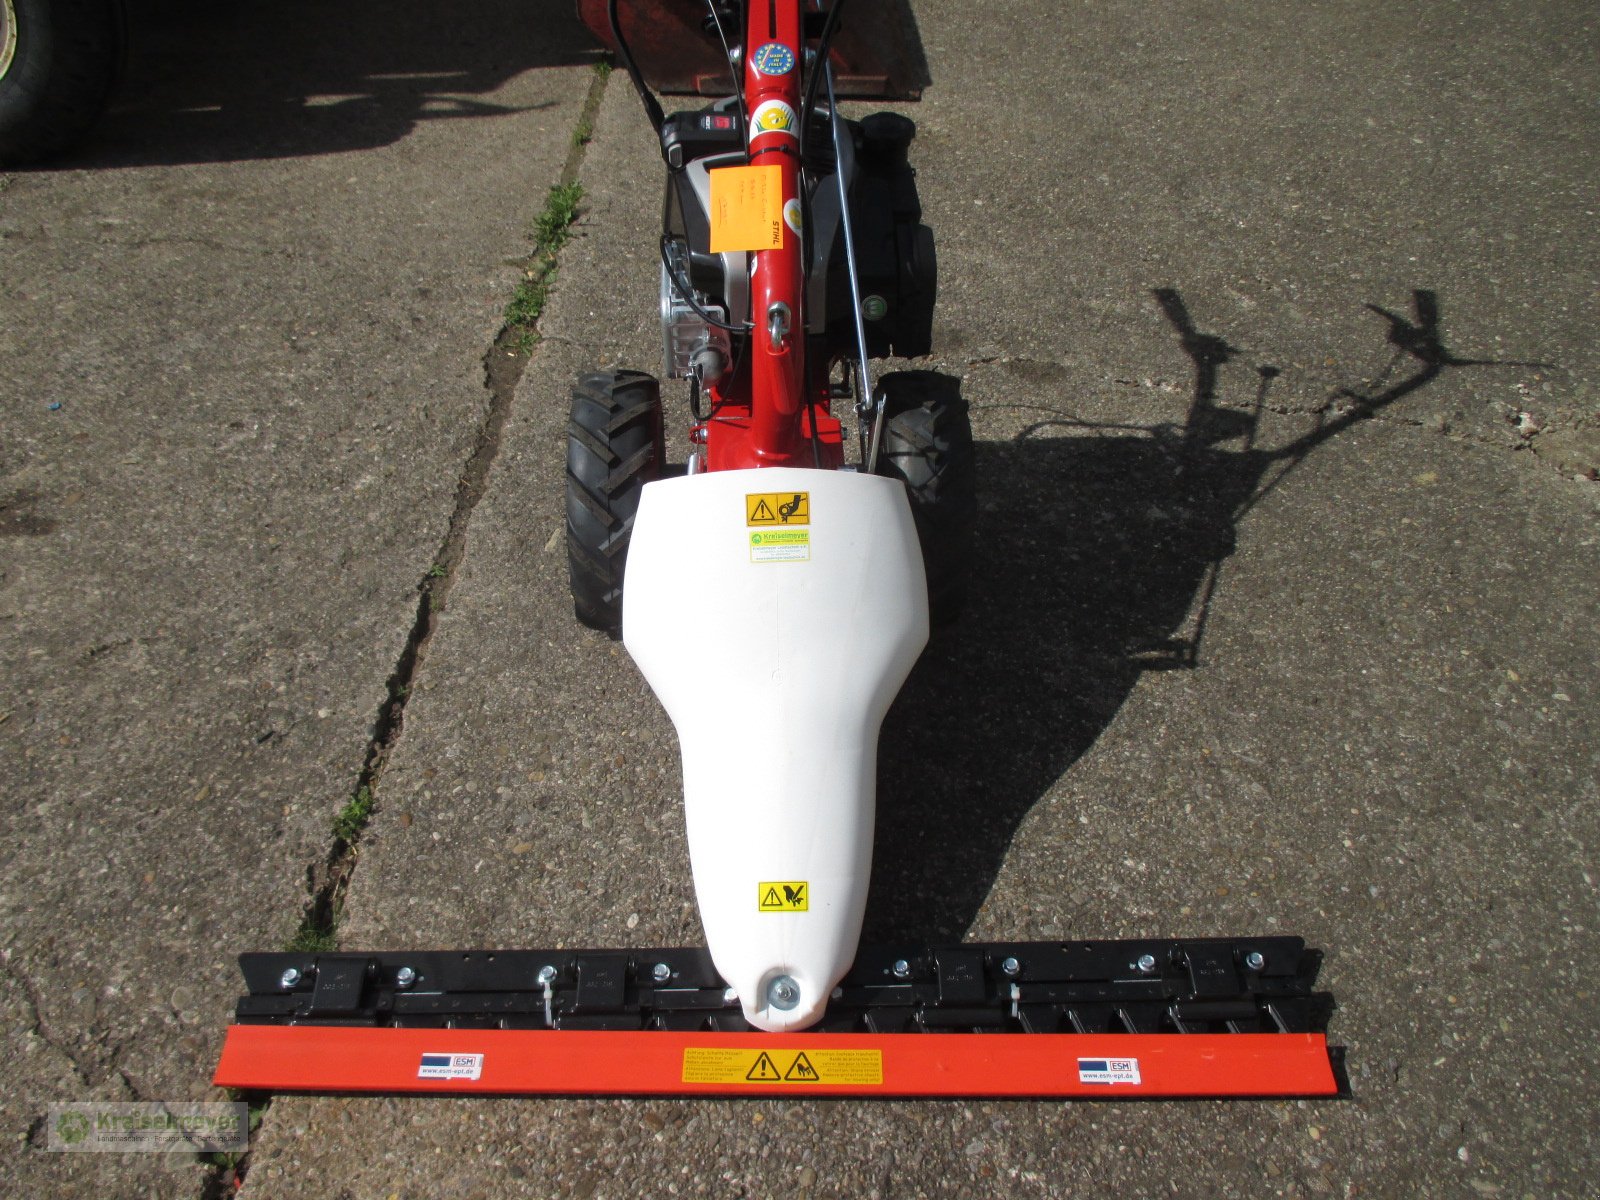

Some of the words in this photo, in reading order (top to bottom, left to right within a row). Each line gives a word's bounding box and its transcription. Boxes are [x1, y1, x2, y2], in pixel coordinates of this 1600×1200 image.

[772, 220, 780, 245] STIHL
[763, 532, 808, 540] Kreiselmeyer
[455, 1058, 474, 1066] ESM
[1112, 1062, 1130, 1070] ESM
